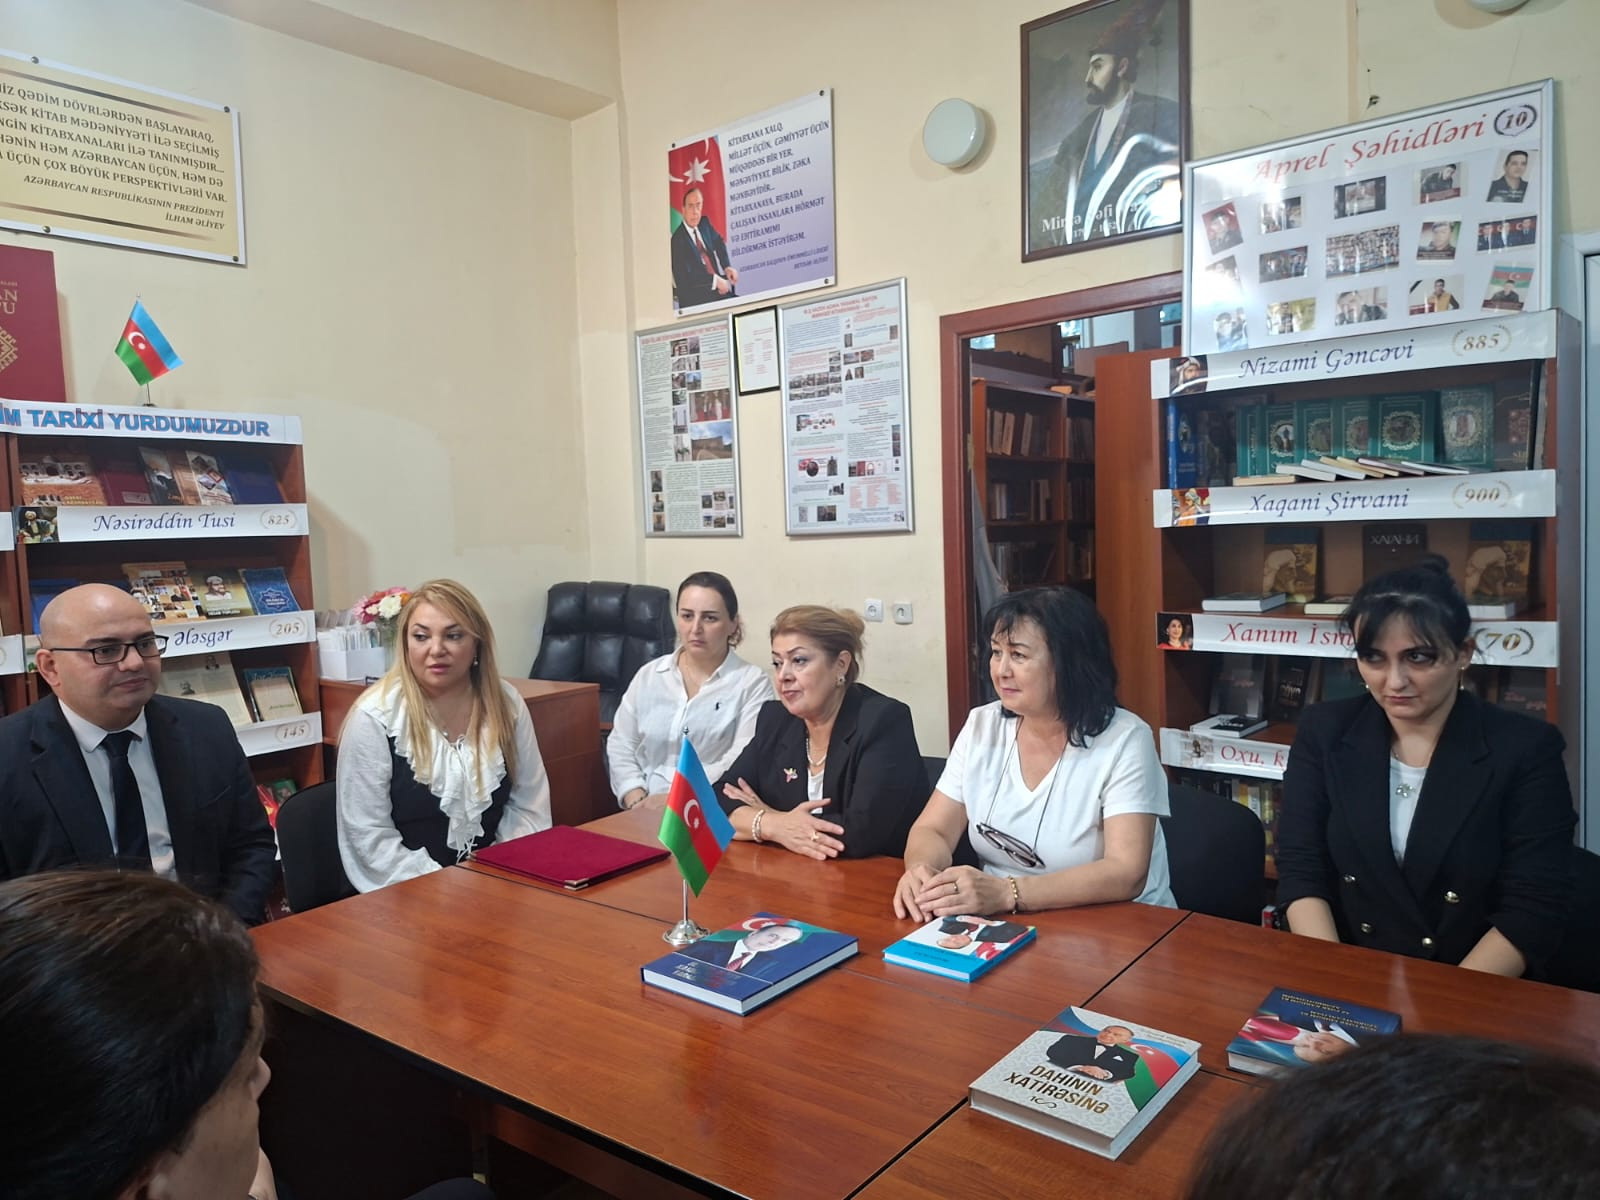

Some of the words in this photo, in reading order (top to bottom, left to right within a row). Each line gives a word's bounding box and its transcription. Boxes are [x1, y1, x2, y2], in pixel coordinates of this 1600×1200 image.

[0, 83, 15, 96] İZ
[17, 88, 60, 106] QƏDİM
[63, 99, 142, 125] DÖVRLƏRDƏN
[145, 118, 214, 143] BAŞLAYARAQ,
[1503, 110, 1527, 130] 10
[31, 107, 68, 123] KİTAB
[70, 116, 151, 142] MƏDƏNİYYƏTİ
[154, 135, 171, 147] İLƏ
[173, 140, 220, 159] SEÇİLMİŞ
[31, 123, 125, 152] KİTABXANALARI
[128, 142, 146, 156] İLƏ
[728, 146, 753, 160] MİLLƏT
[774, 127, 809, 146] CƏMİYYƏT
[809, 120, 830, 135] ÜÇÜN
[1253, 143, 1335, 183] Aprel
[1344, 113, 1488, 168] Şəhidləri
[6, 149, 40, 166] ÜÇÜN
[43, 158, 67, 172] ÇOX
[70, 163, 110, 180] BÖYÜK
[112, 172, 203, 198] PERSPEKTİVLƏRİ
[205, 190, 228, 203] VAR.
[40, 142, 68, 156] HƏM
[71, 149, 146, 171] AZƏRBAYCAN
[182, 171, 206, 184] HƏM
[209, 177, 224, 188] DƏ
[23, 175, 89, 193] AZƏRBAYCAN
[91, 186, 172, 209] RESPUBLİKASININ
[174, 202, 225, 219] PREZİDENTİ
[165, 212, 194, 225] İLHAM
[195, 218, 225, 230] ƏLİYEV
[1042, 215, 1082, 232] Mirə
[1463, 333, 1500, 352] 885
[1238, 350, 1318, 379] Nizami
[1325, 338, 1415, 374] Gəncəvi
[27, 408, 105, 430] TARİXİ
[107, 412, 271, 437] YURDUMUZDUR
[1250, 492, 1321, 518] Xaqani
[1325, 488, 1410, 516] Şirvani
[1464, 488, 1501, 503] 900
[92, 511, 193, 532] Nəsirəddin
[198, 511, 236, 529] Tusi
[267, 514, 290, 526] 825
[174, 627, 233, 648] Ələsgər
[275, 621, 300, 635] 205
[1220, 622, 1298, 643] Xanım
[1485, 632, 1522, 651] 70
[282, 725, 305, 739] 145
[1003, 1071, 1110, 1115] XATİRƏSİNƏ
[1029, 1064, 1104, 1097] DAHİNİN
